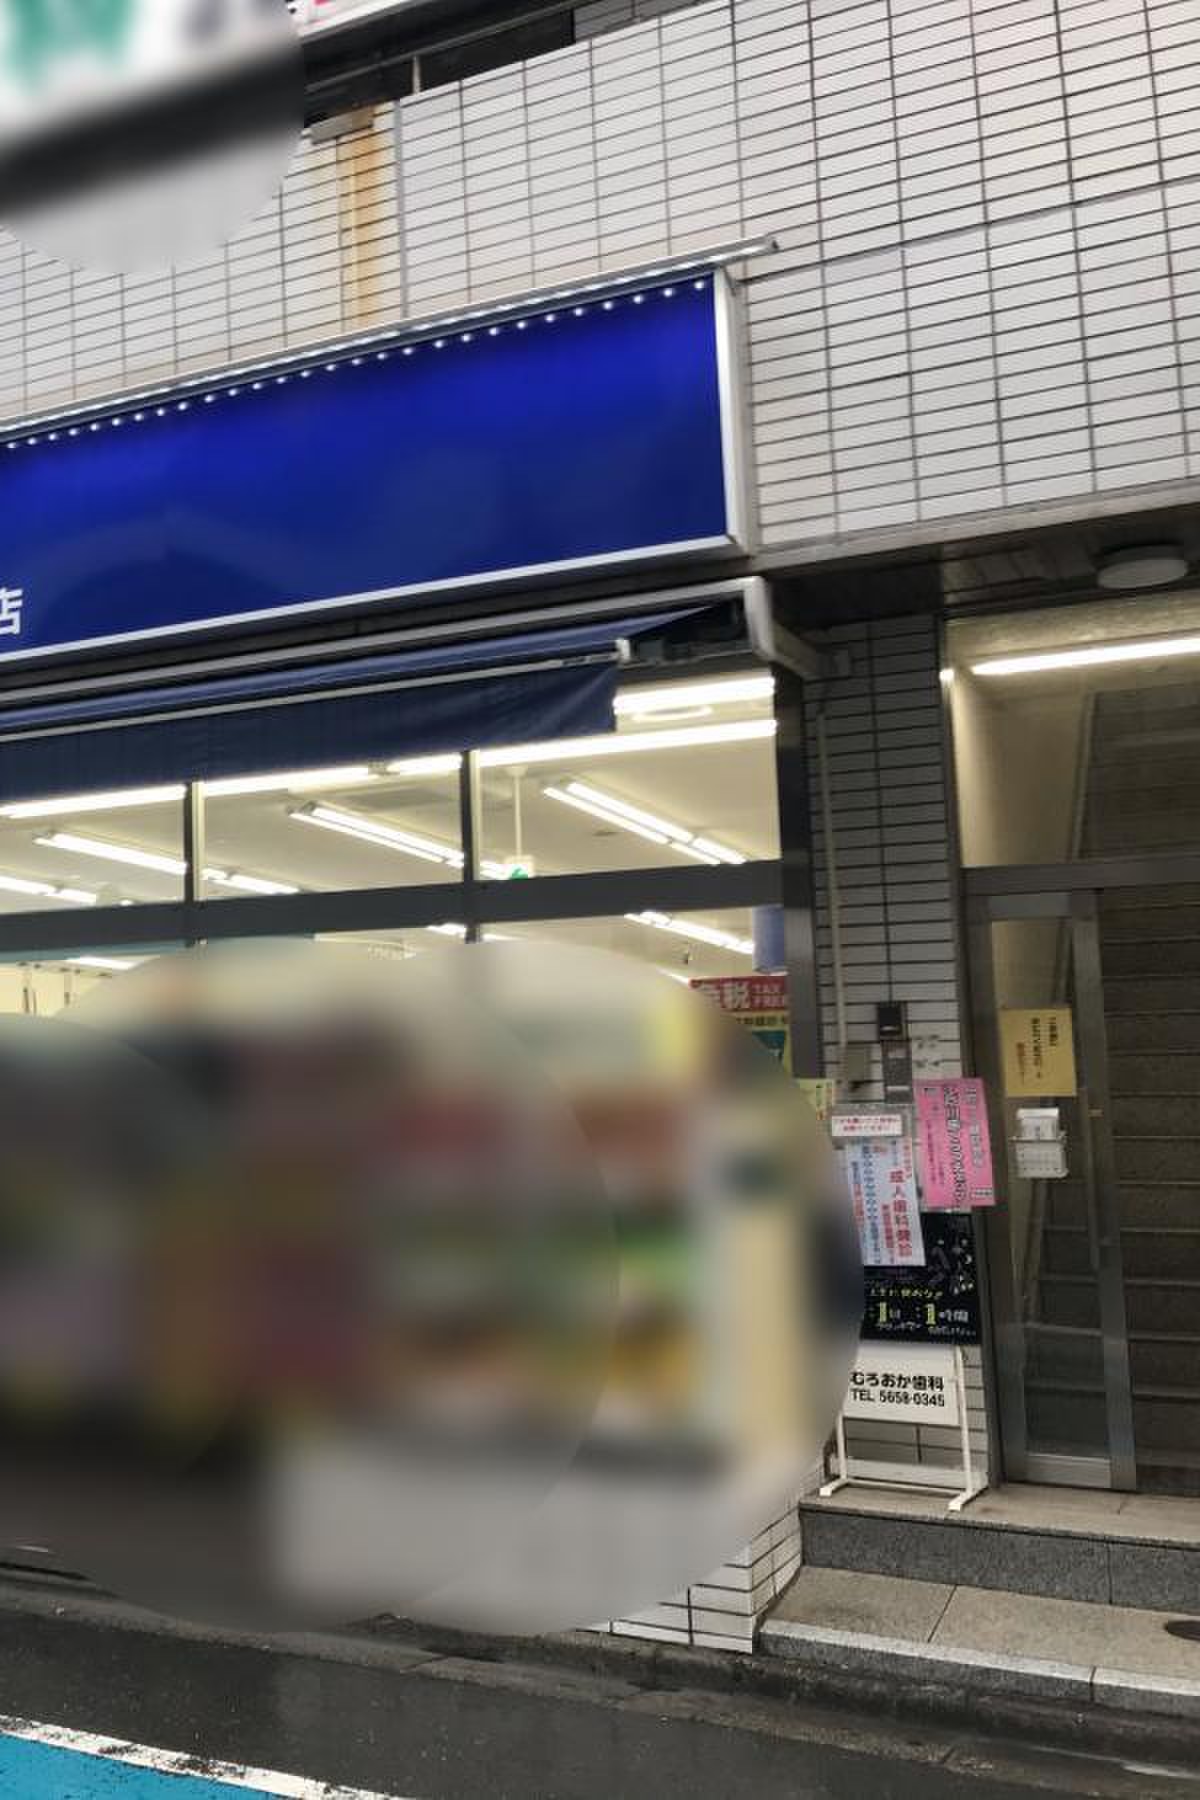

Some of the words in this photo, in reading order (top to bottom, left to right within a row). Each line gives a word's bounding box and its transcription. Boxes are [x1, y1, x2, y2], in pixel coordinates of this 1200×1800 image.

[850, 1371, 945, 1392] むろおか歯科
[850, 1388, 875, 1402] TEL
